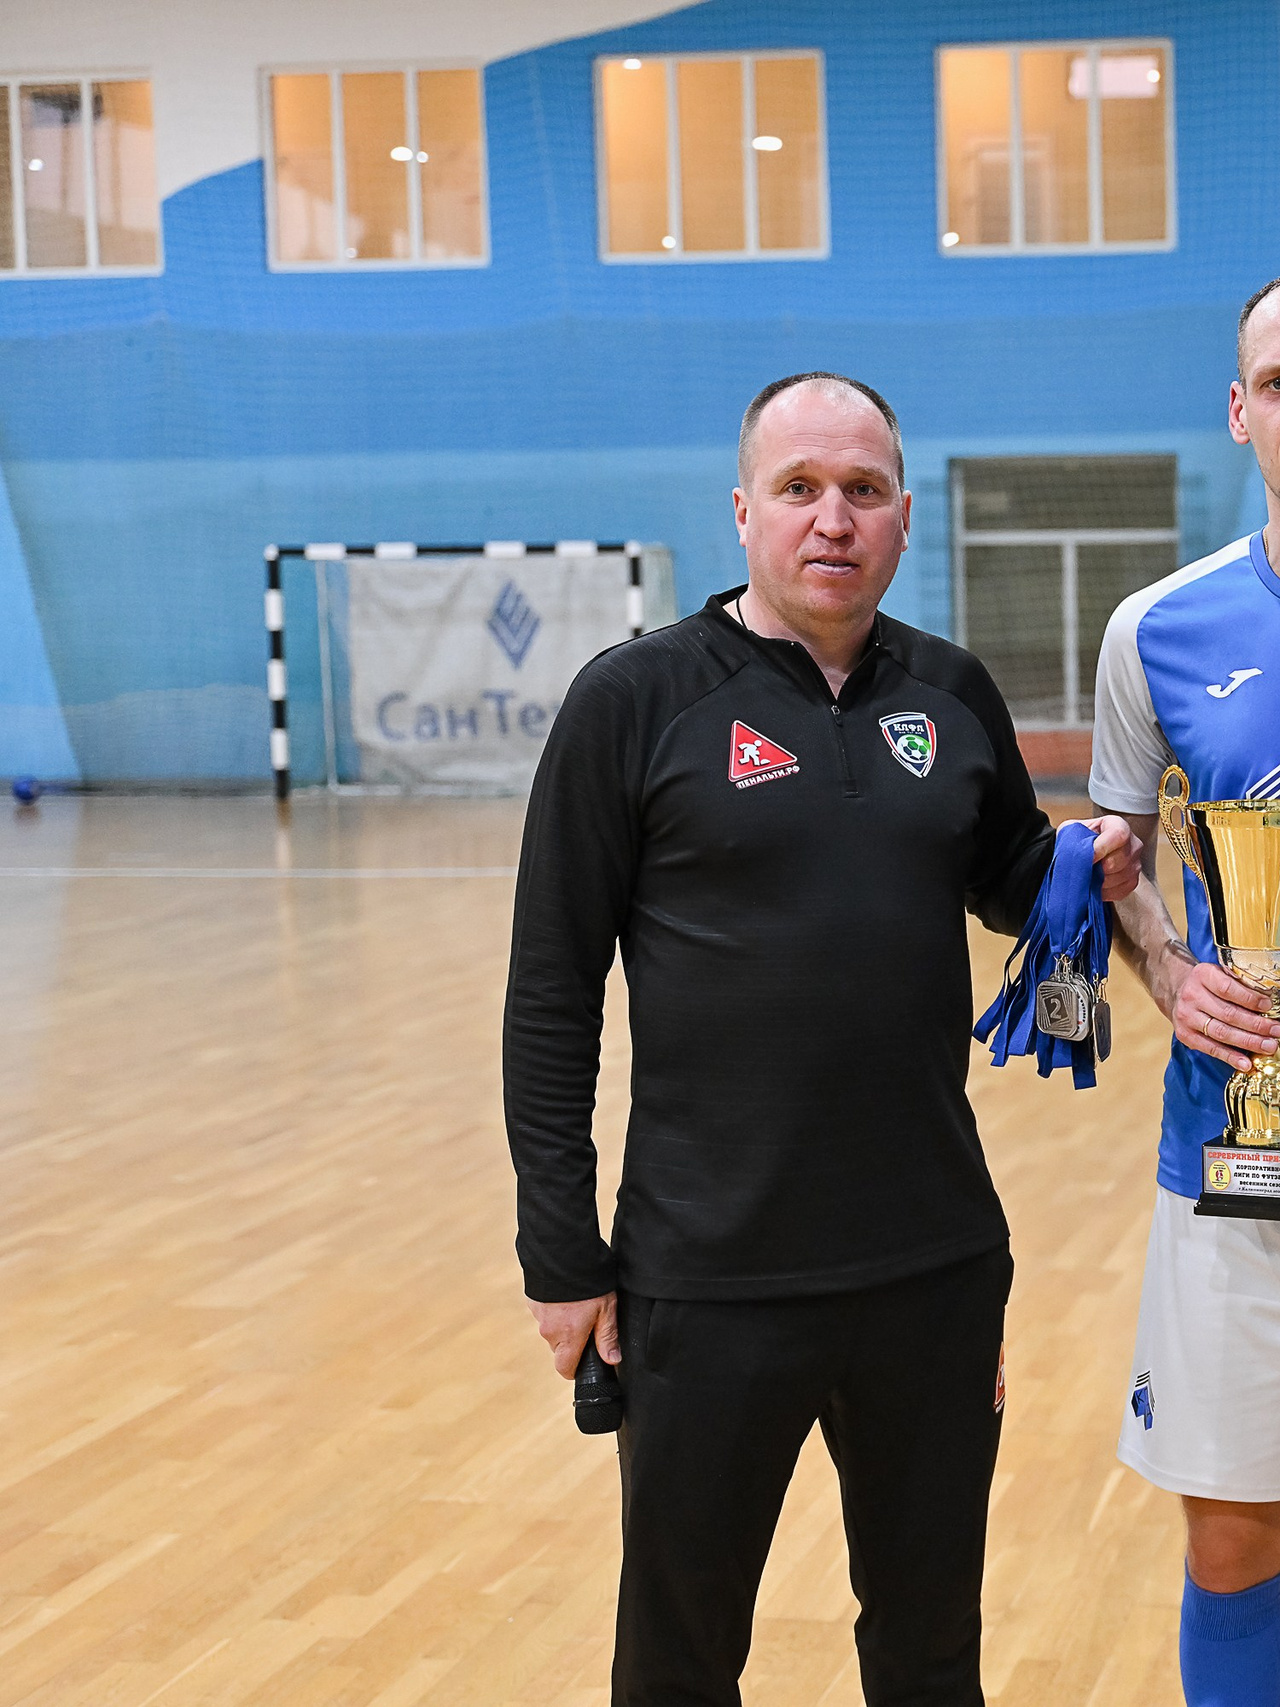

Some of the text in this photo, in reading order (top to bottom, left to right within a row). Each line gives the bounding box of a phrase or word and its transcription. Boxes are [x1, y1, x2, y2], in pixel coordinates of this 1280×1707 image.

[376, 688, 562, 742] СанТе
[735, 765, 800, 790] ПЕНАЛЬТИ.РФ
[1050, 998, 1062, 1019] 2
